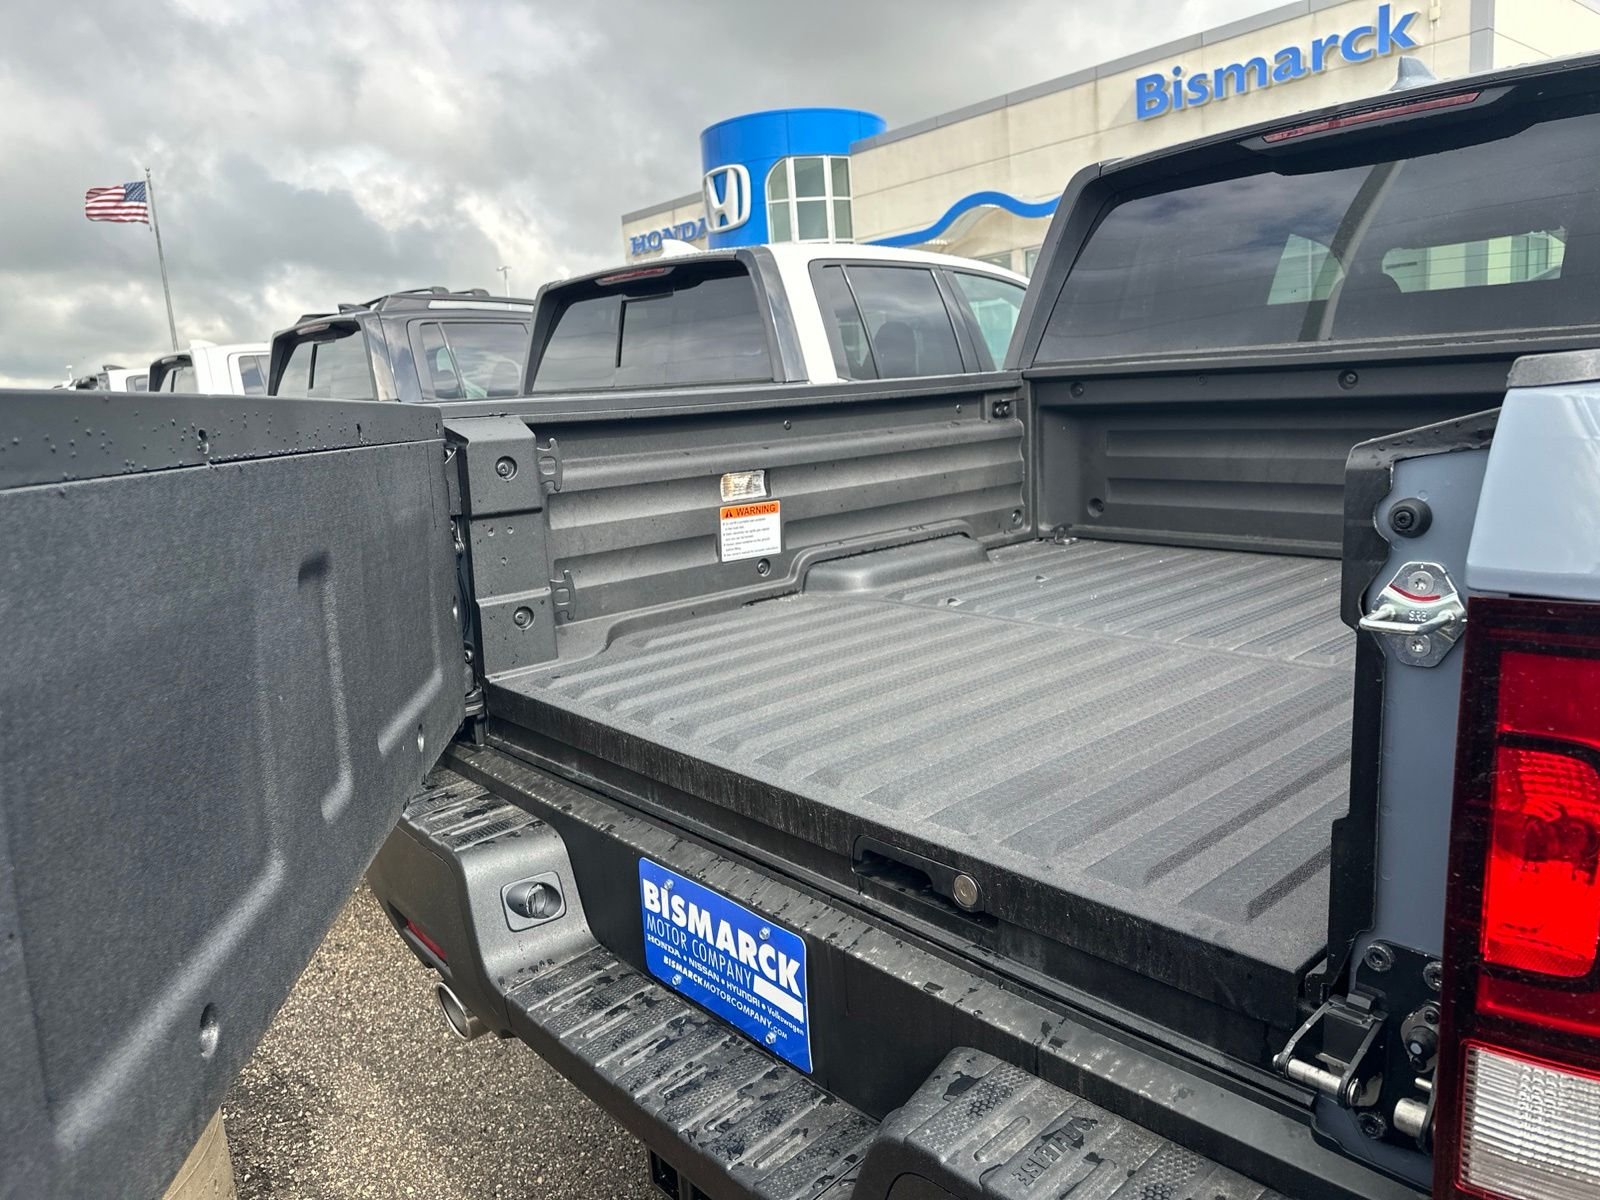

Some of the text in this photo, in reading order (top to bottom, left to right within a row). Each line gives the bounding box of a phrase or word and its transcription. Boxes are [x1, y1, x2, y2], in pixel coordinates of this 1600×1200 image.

[1136, 3, 1419, 120] Bismarck
[736, 504, 776, 517] WARNING
[643, 879, 802, 998] BISMARCK
[647, 913, 752, 989] MOTOR COMPANY
[647, 933, 804, 1036] HONDA NISSAN HYUNDAI Volkswagen
[663, 955, 788, 1040] BISMARCKMOTORCOMPANY.COM
